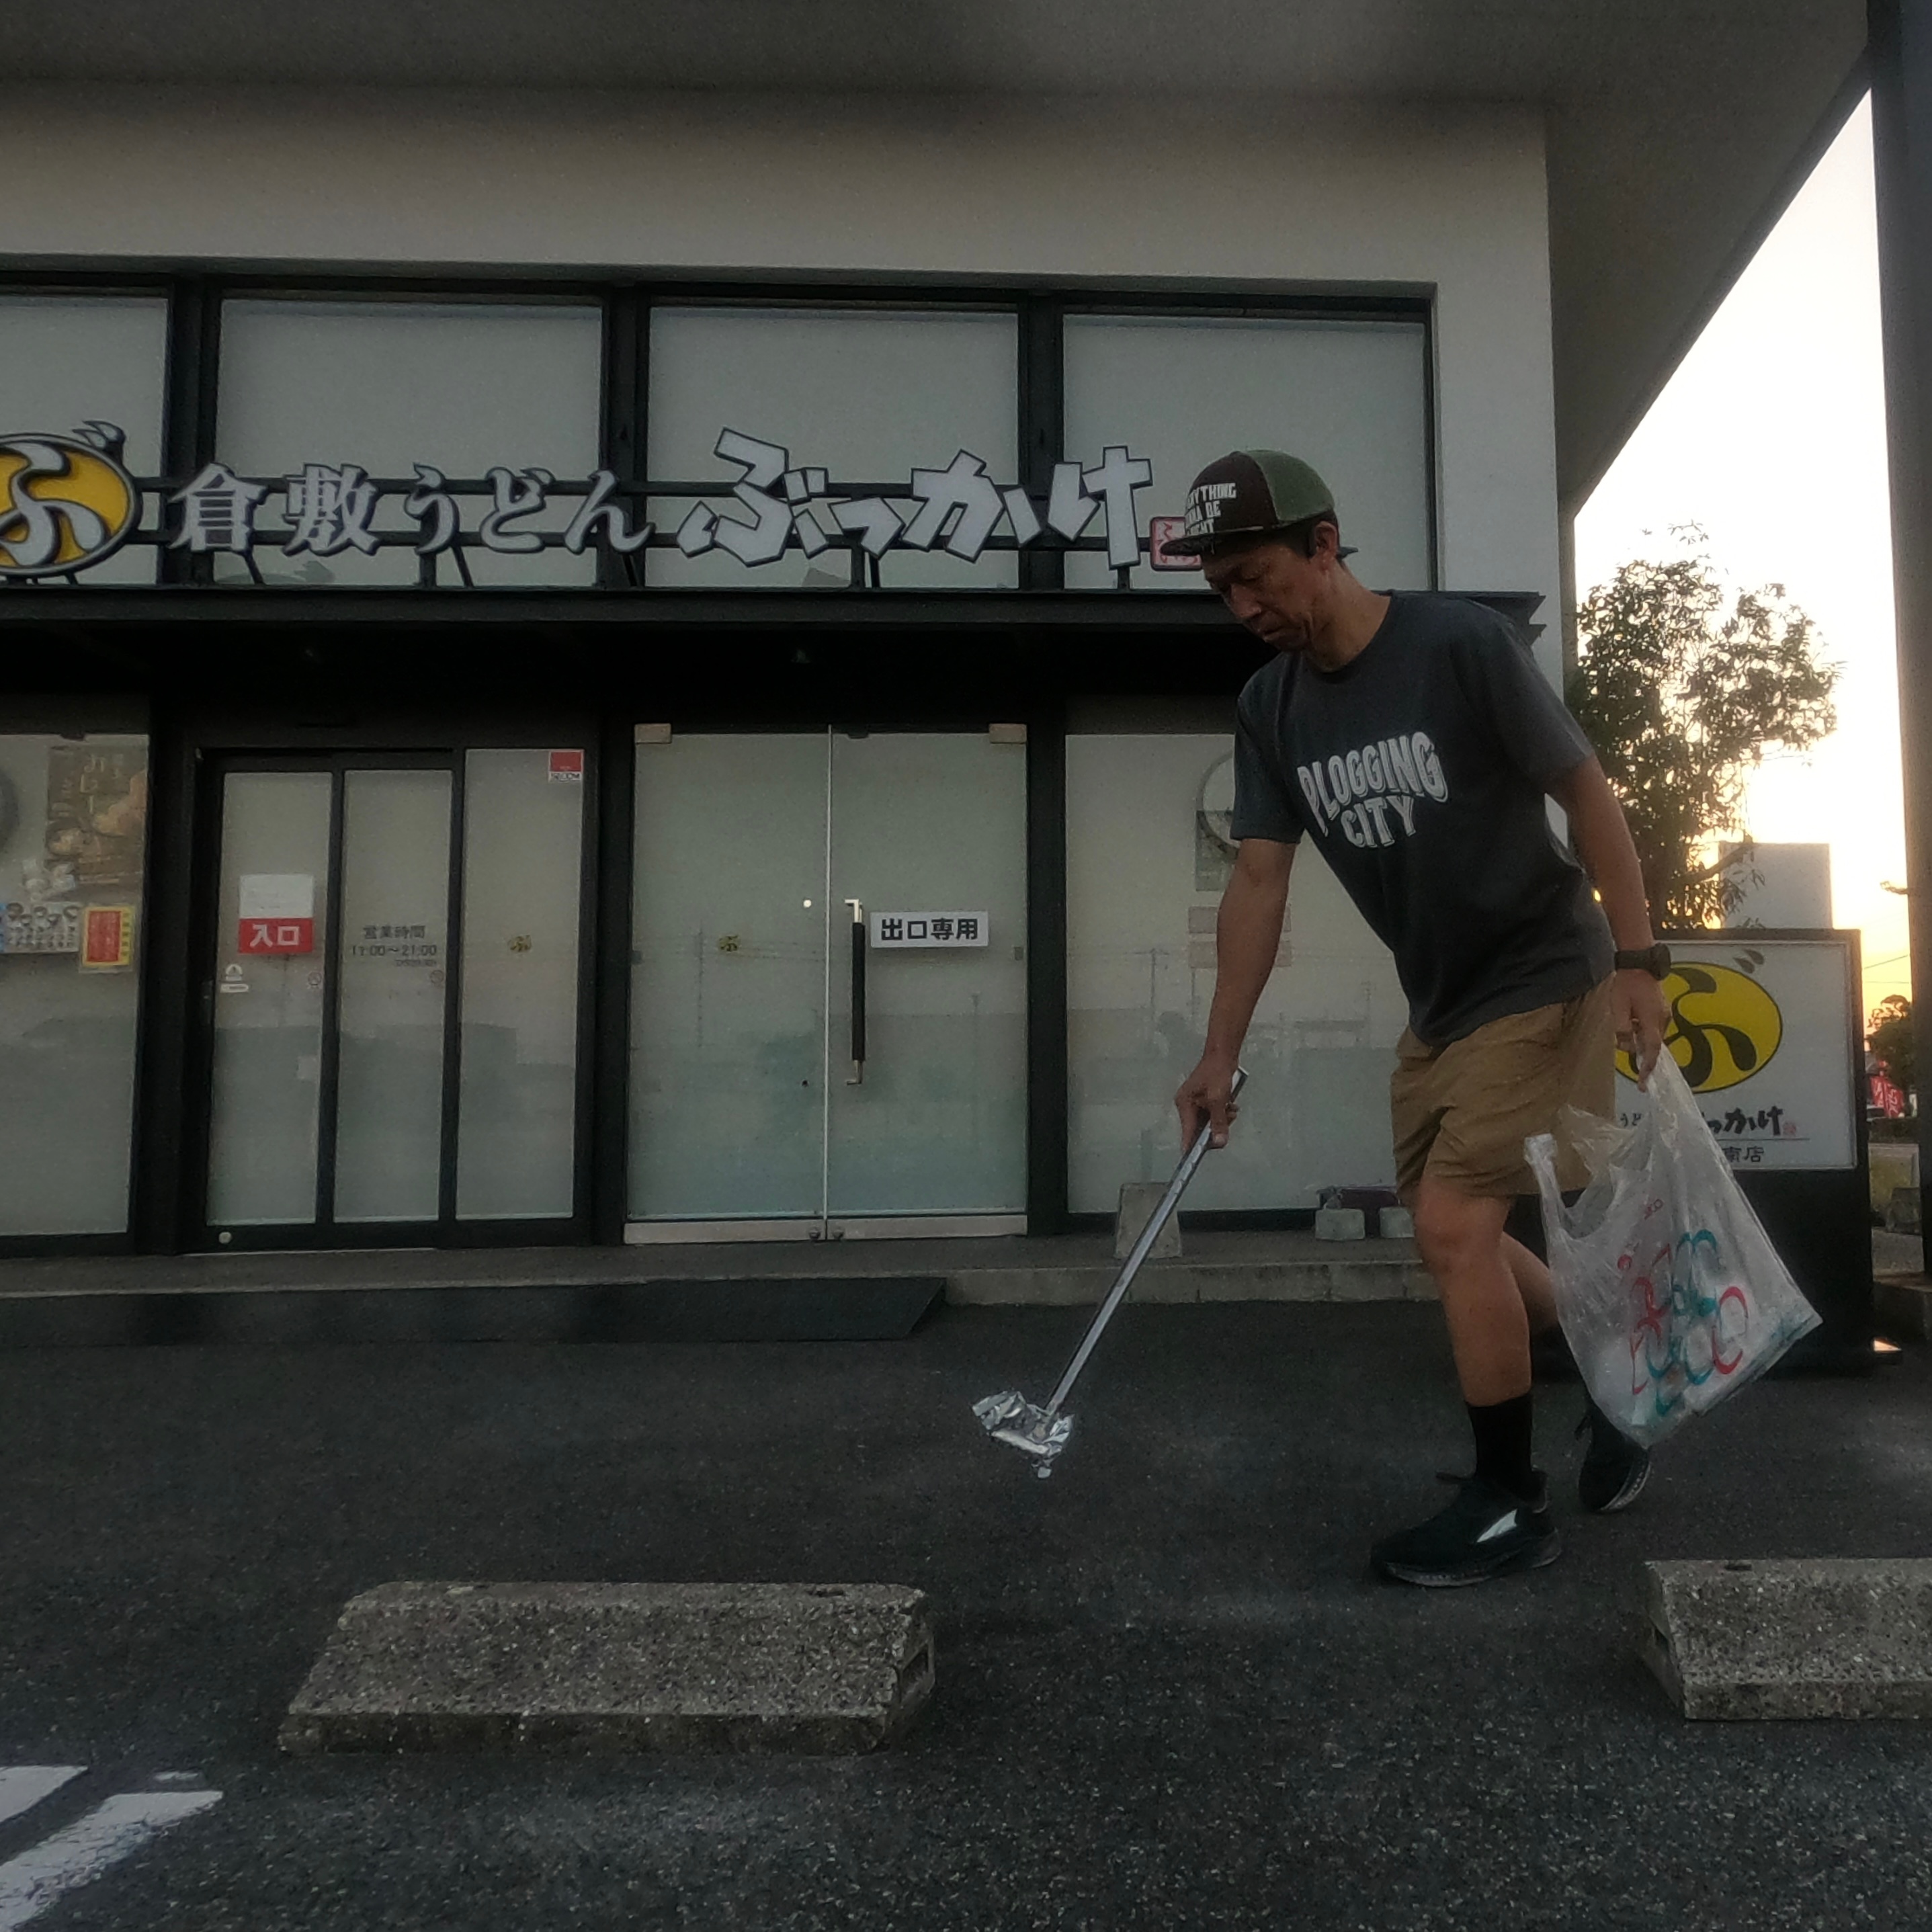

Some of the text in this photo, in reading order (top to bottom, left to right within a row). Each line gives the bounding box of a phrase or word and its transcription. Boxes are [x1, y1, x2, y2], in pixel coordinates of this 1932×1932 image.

[169, 463, 656, 557] 倉敷うどん
[675, 427, 1153, 570] ぶっかけ
[1296, 731, 1449, 837] PLOGGING
[1339, 795, 1417, 849] CITY
[249, 923, 300, 948] 入口
[881, 917, 978, 941] 出口専用
